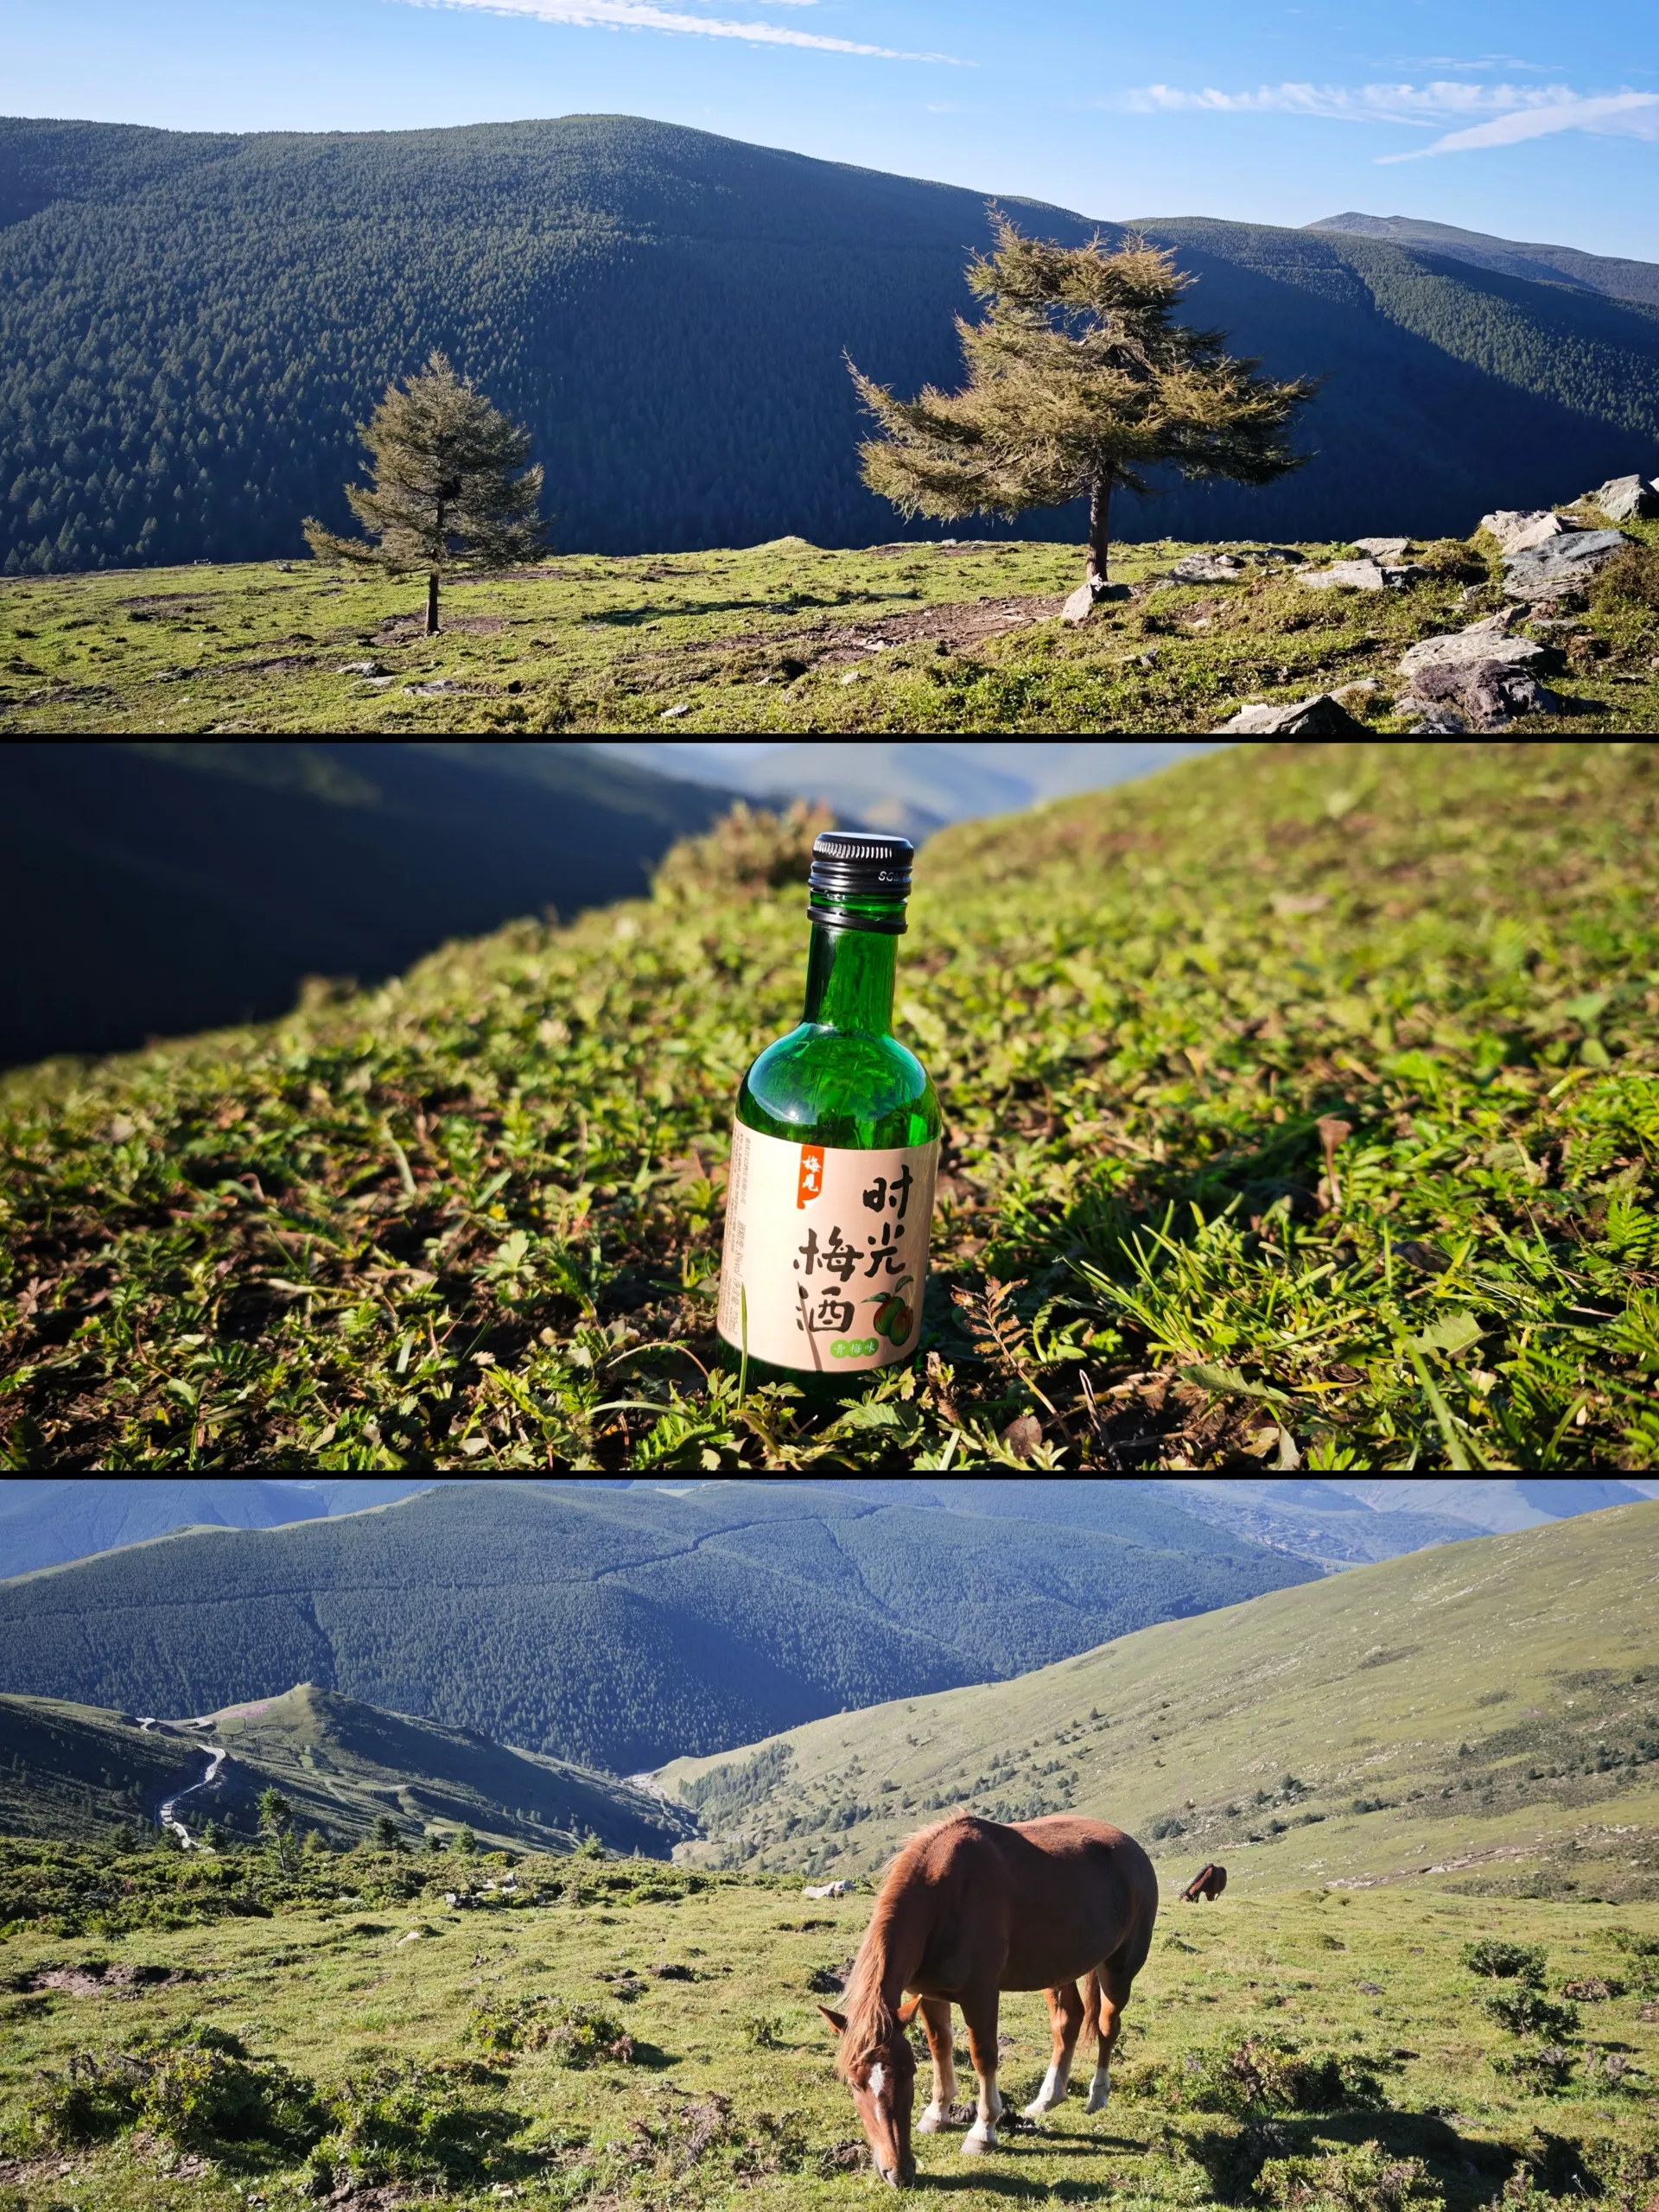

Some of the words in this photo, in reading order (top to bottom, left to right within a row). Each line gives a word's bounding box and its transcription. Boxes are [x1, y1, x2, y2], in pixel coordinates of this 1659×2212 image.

[862, 1164, 913, 1278] 时光
[792, 1225, 865, 1333] 梅酒
[833, 1341, 875, 1356] 青梅味
